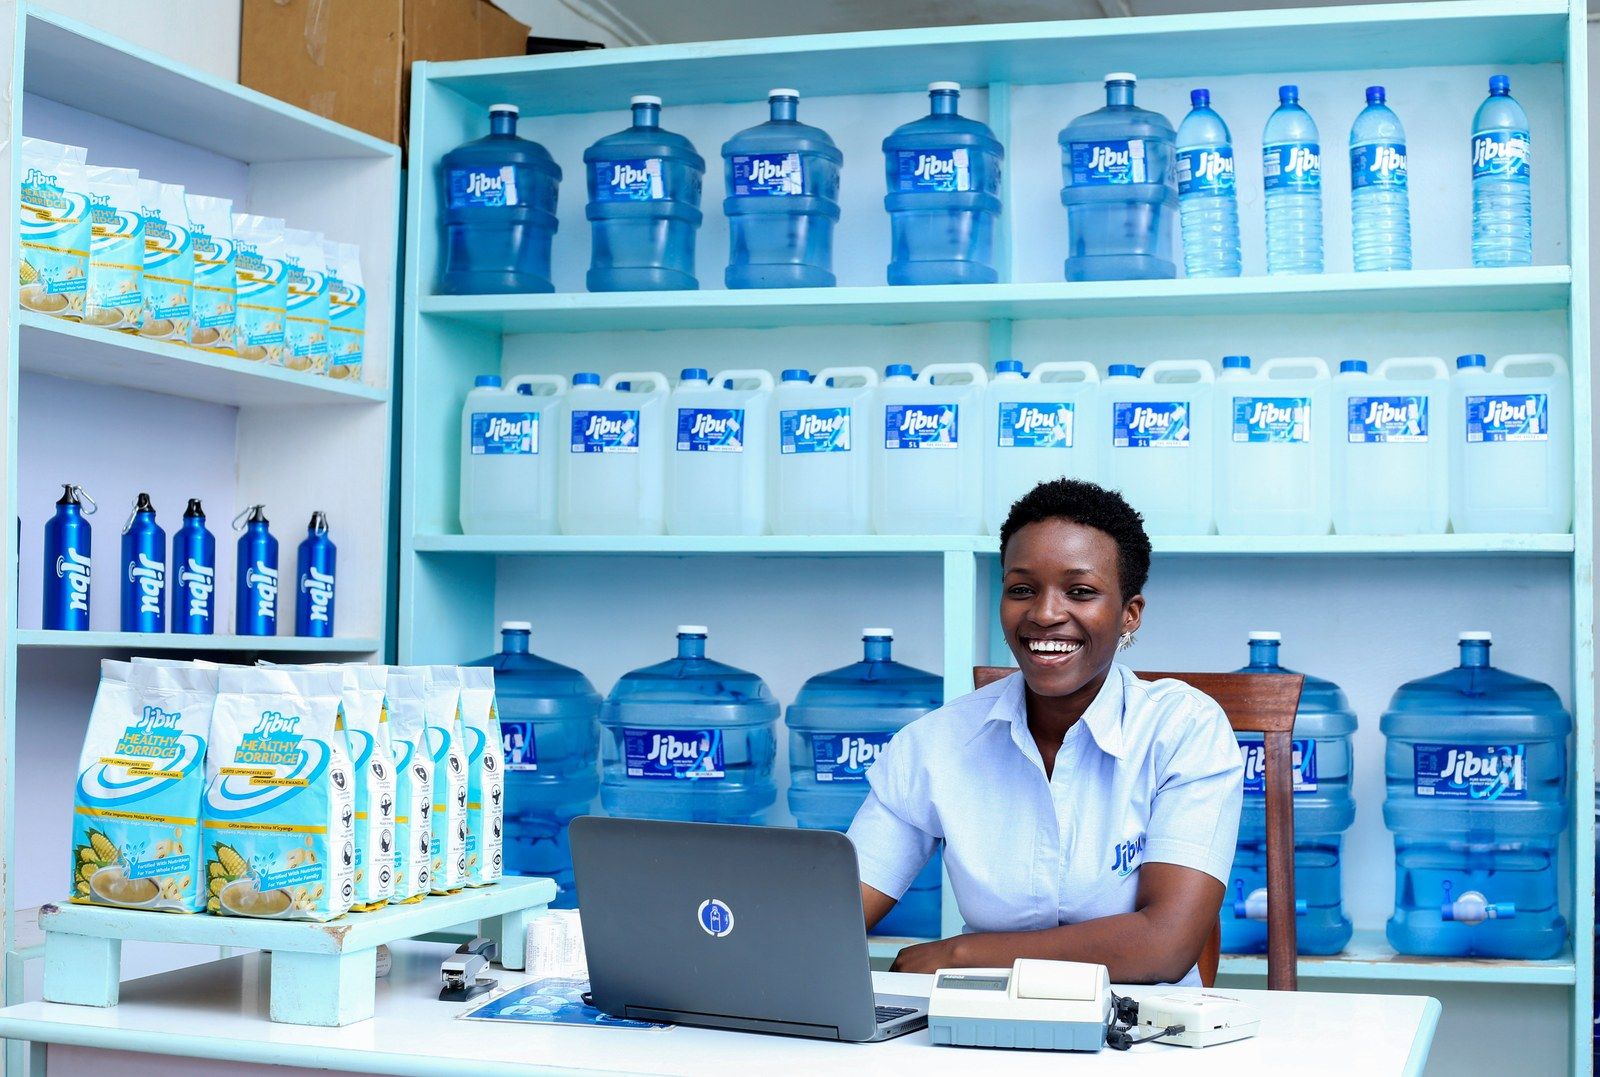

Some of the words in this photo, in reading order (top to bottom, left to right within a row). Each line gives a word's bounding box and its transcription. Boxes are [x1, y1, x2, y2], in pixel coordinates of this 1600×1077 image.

[1088, 146, 1129, 173] Jibu
[1195, 151, 1234, 181] Jibu
[1285, 147, 1321, 178] Jibu
[1370, 146, 1408, 177] Jibu
[1473, 137, 1511, 168] Jibu
[25, 168, 57, 189] Jibu
[611, 164, 649, 191] Jibu
[749, 159, 786, 185] Jibu
[915, 154, 956, 181] Jibu
[466, 173, 502, 198] Jibu
[691, 413, 727, 438] Jibu
[796, 414, 834, 440] Jibu
[900, 409, 939, 435] Jibu
[1015, 407, 1055, 433] Jibu
[1128, 406, 1170, 433] Jibu
[1249, 401, 1292, 428] Jibu
[1365, 400, 1407, 428] Jibu
[1483, 400, 1526, 427] Jibu
[485, 417, 522, 442] Jibu
[586, 415, 622, 440] Jibu
[62, 547, 91, 611] Jibu
[133, 553, 164, 613] Jibu
[182, 558, 213, 617] Jibu
[251, 560, 278, 618] Jibu
[305, 566, 334, 621] Jibu
[138, 706, 177, 733] Jibu
[253, 711, 296, 739] Jibu
[117, 744, 176, 757] PORRIDGE
[125, 733, 177, 746] HEALTHY
[242, 740, 298, 752] HEALTHY
[647, 734, 698, 766] Jibu
[236, 750, 298, 764] PORRIDGE
[1441, 749, 1498, 785] Jibu
[1111, 836, 1143, 871] Jibu
